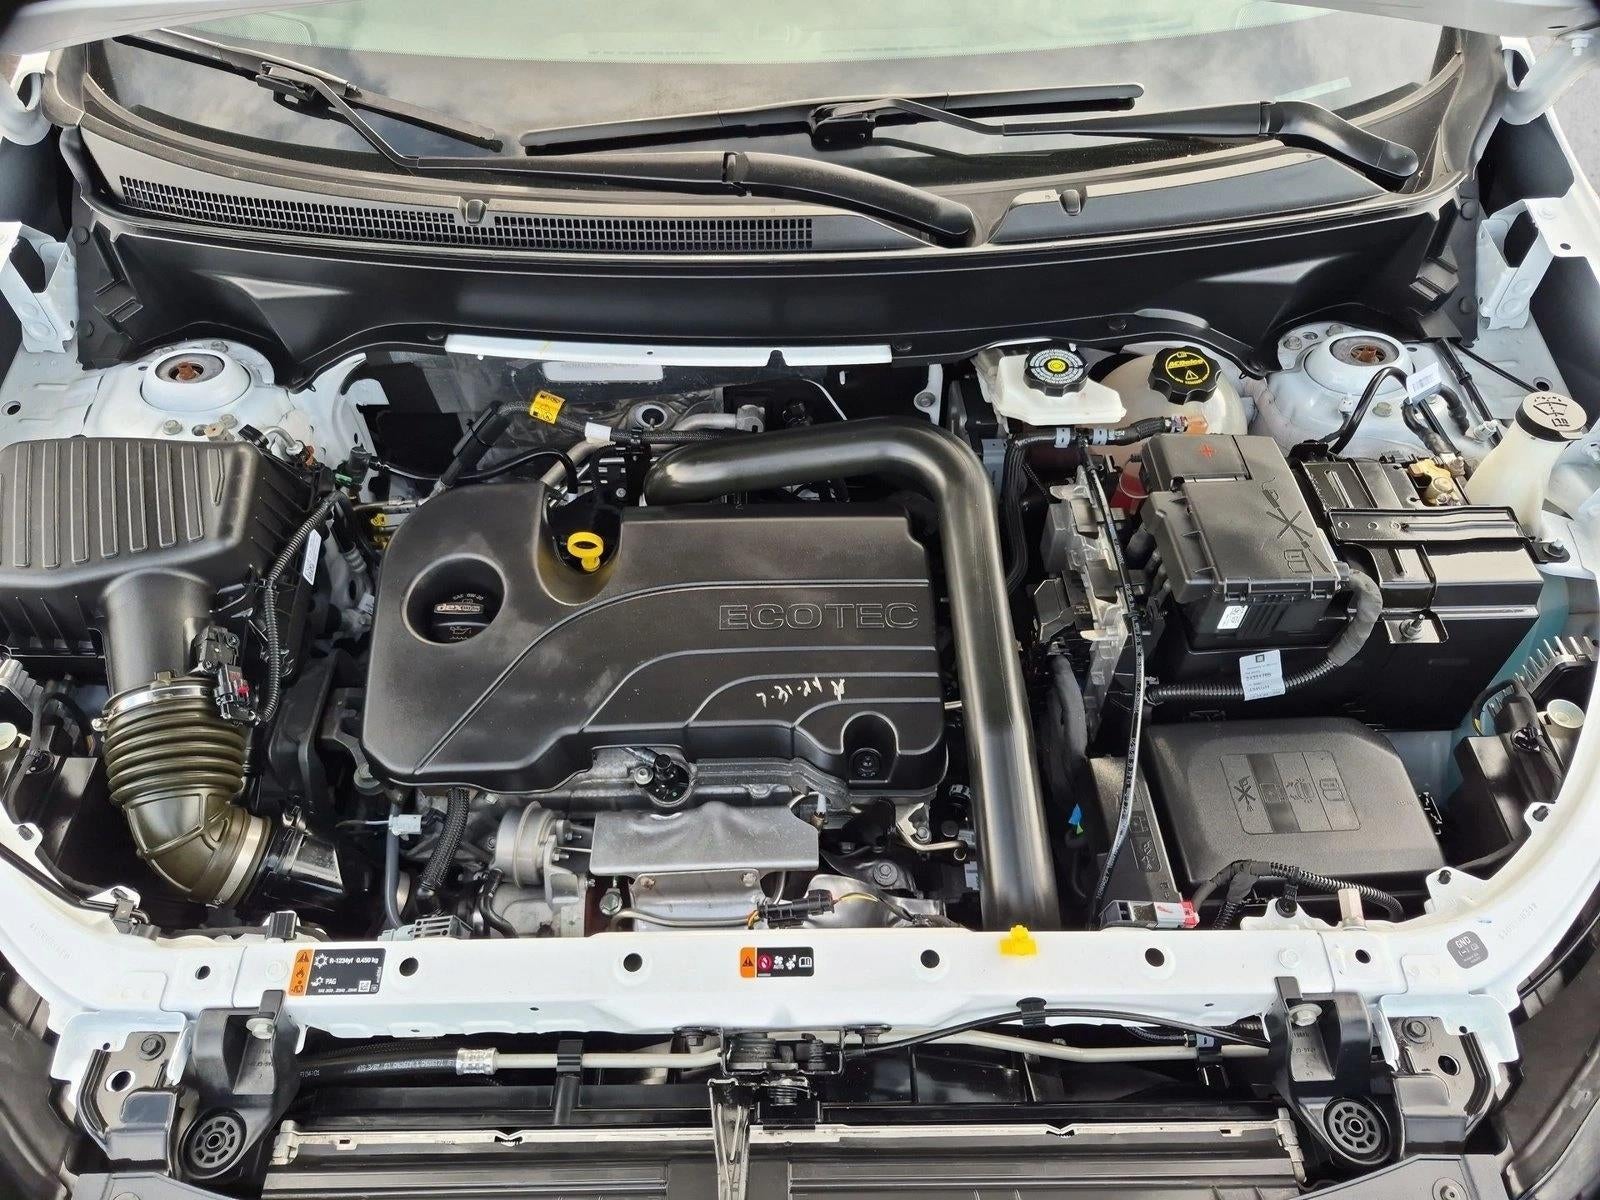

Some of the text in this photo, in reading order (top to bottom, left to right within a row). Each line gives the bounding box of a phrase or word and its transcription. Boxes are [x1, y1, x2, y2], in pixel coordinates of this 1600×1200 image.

[719, 602, 919, 630] ECOTEC
[1455, 936, 1471, 948] GND
[329, 957, 353, 965] R-1234yf
